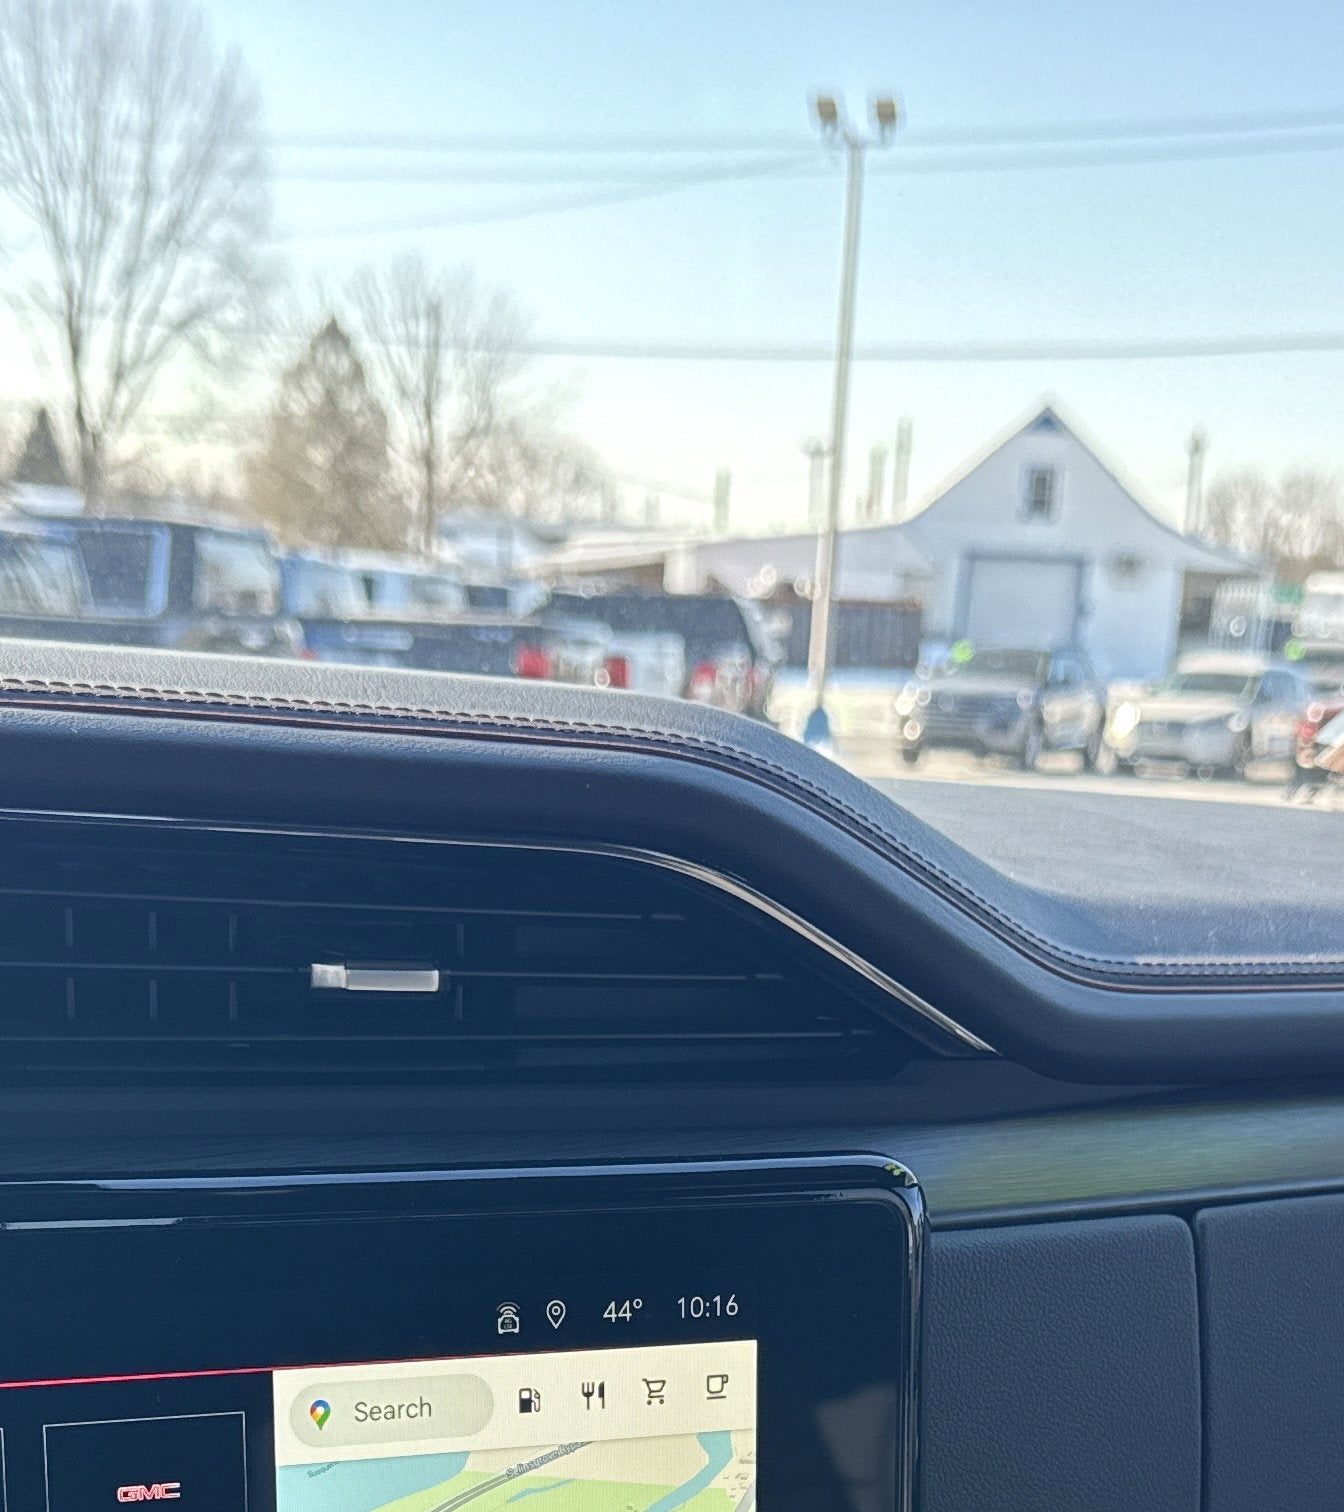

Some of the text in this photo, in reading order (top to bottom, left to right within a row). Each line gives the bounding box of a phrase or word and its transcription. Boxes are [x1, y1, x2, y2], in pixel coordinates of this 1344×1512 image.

[677, 1294, 739, 1319] 10:16
[354, 1396, 432, 1423] Search
[116, 1482, 181, 1503] GMC
